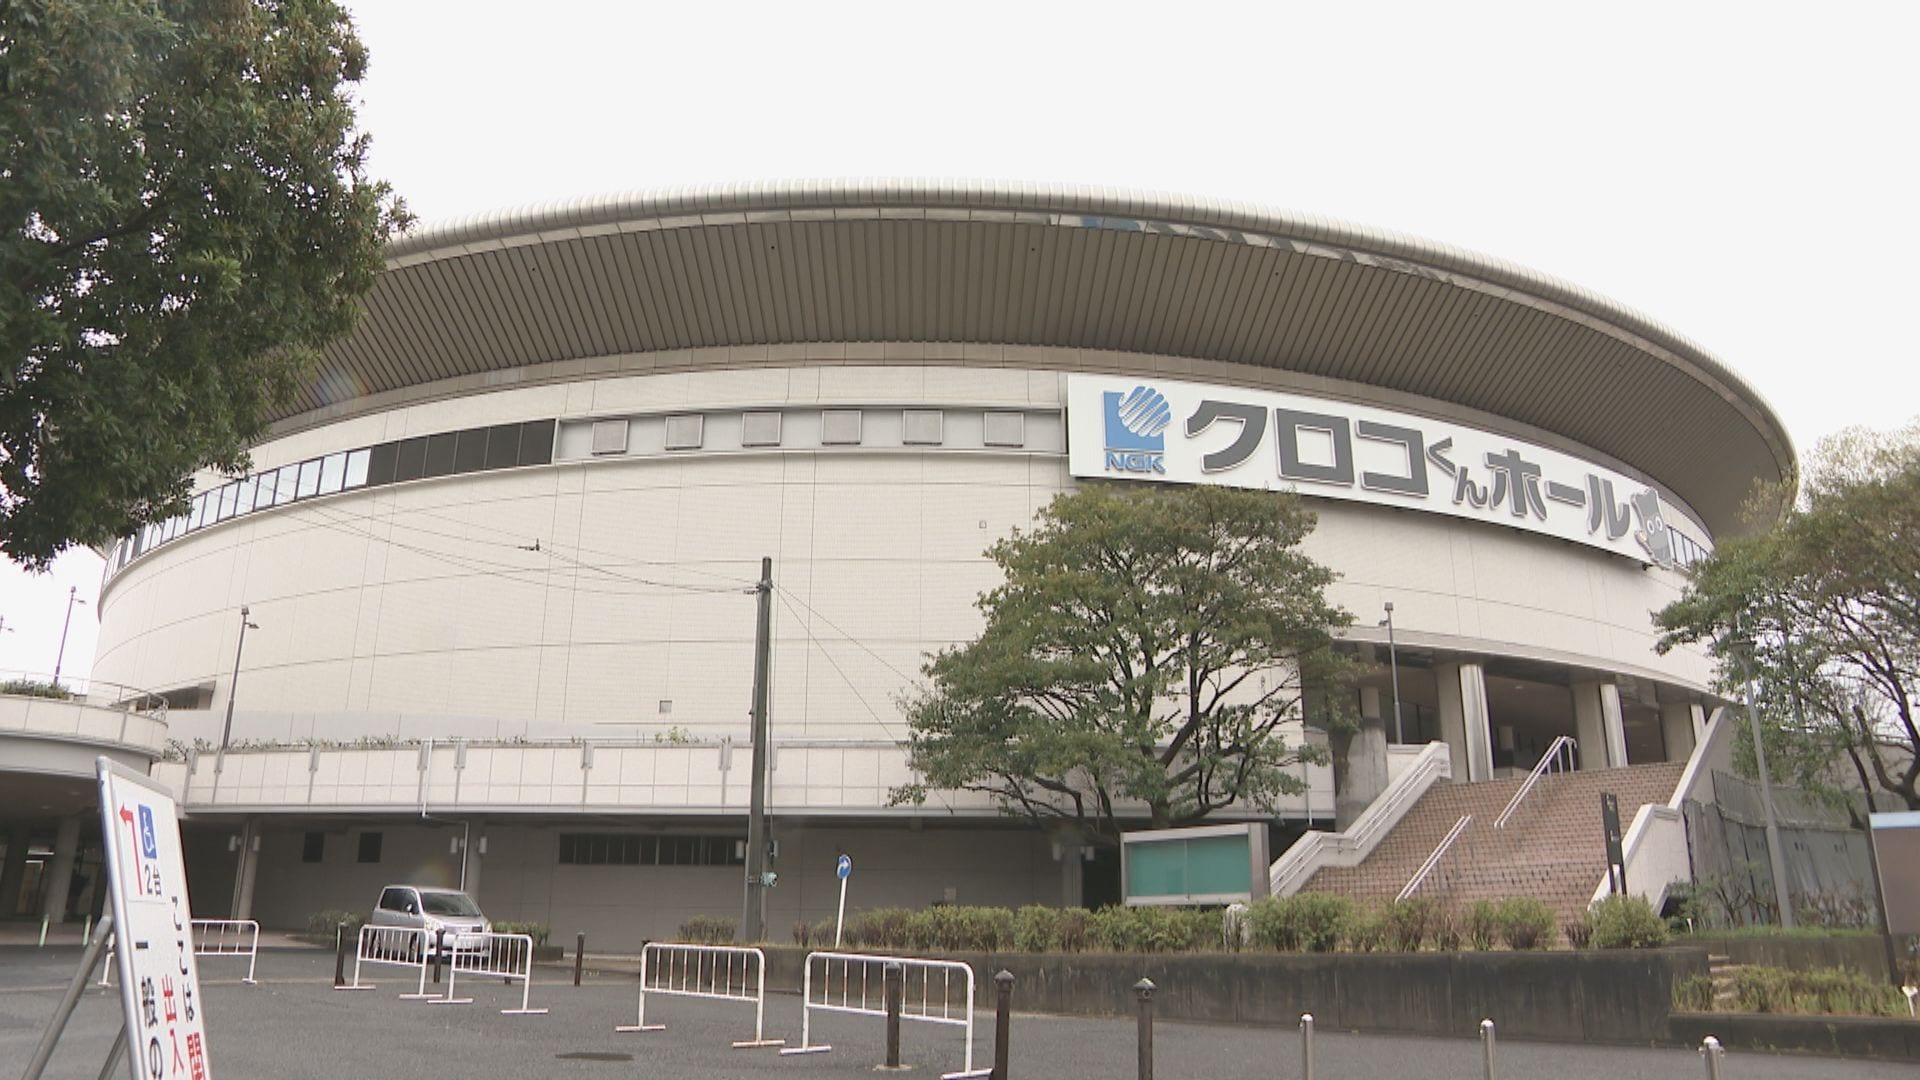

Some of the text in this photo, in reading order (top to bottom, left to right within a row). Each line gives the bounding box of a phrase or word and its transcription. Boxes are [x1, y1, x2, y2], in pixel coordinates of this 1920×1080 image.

[1104, 451, 1166, 474] NGK
[1185, 400, 1631, 540] クロコくんホール
[145, 864, 162, 895] 2台
[162, 973, 184, 1076] 出入
